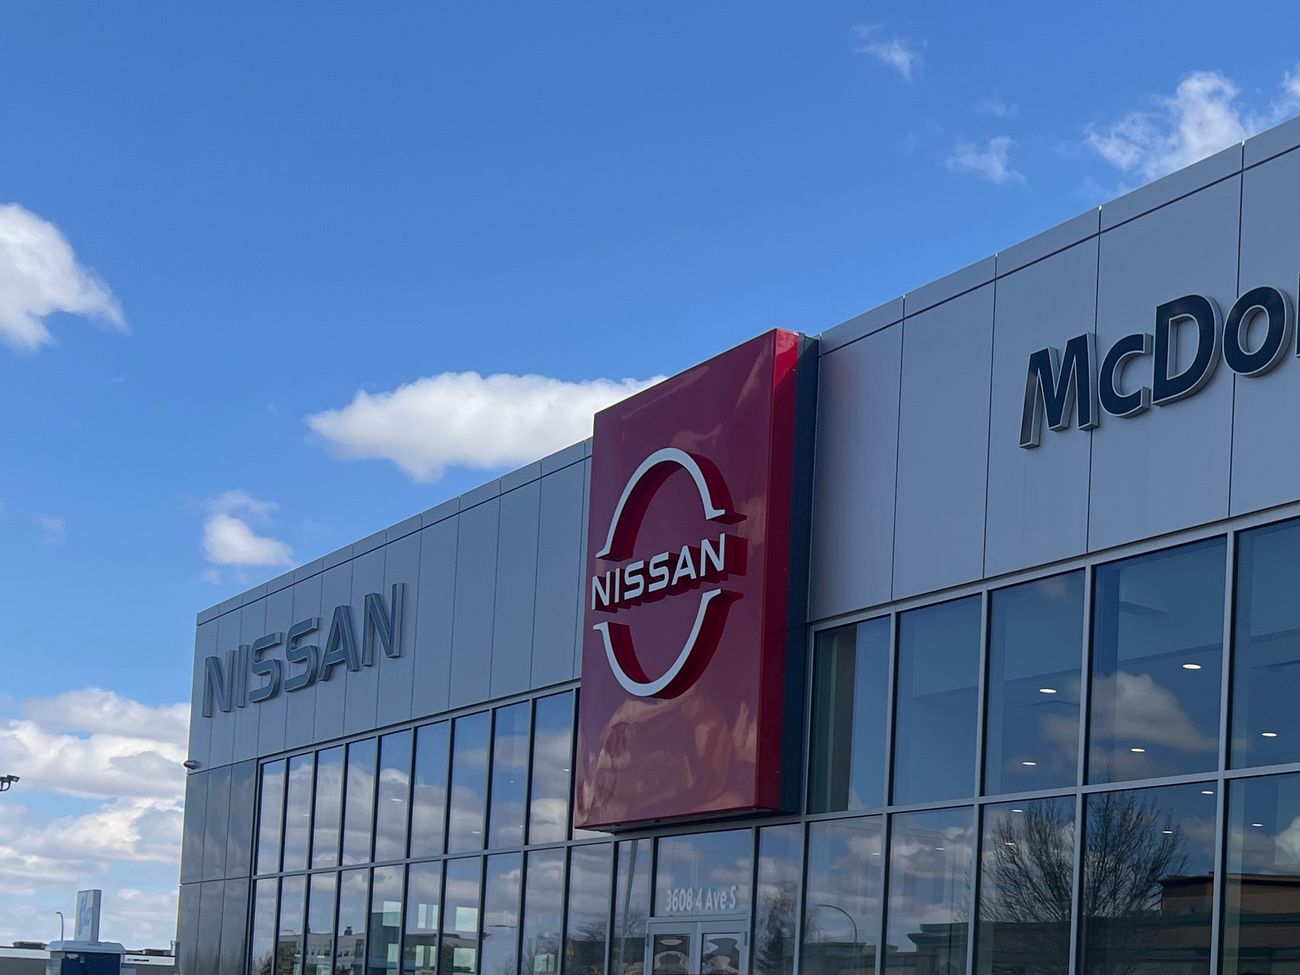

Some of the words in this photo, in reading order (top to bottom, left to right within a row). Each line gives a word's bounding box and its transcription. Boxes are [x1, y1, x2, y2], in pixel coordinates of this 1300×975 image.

[591, 532, 726, 611] NISSAN
[202, 582, 405, 718] NISSAN
[665, 887, 693, 912] 3608
[695, 887, 703, 908] 4
[706, 888, 727, 911] Ave
[730, 885, 738, 910] S
